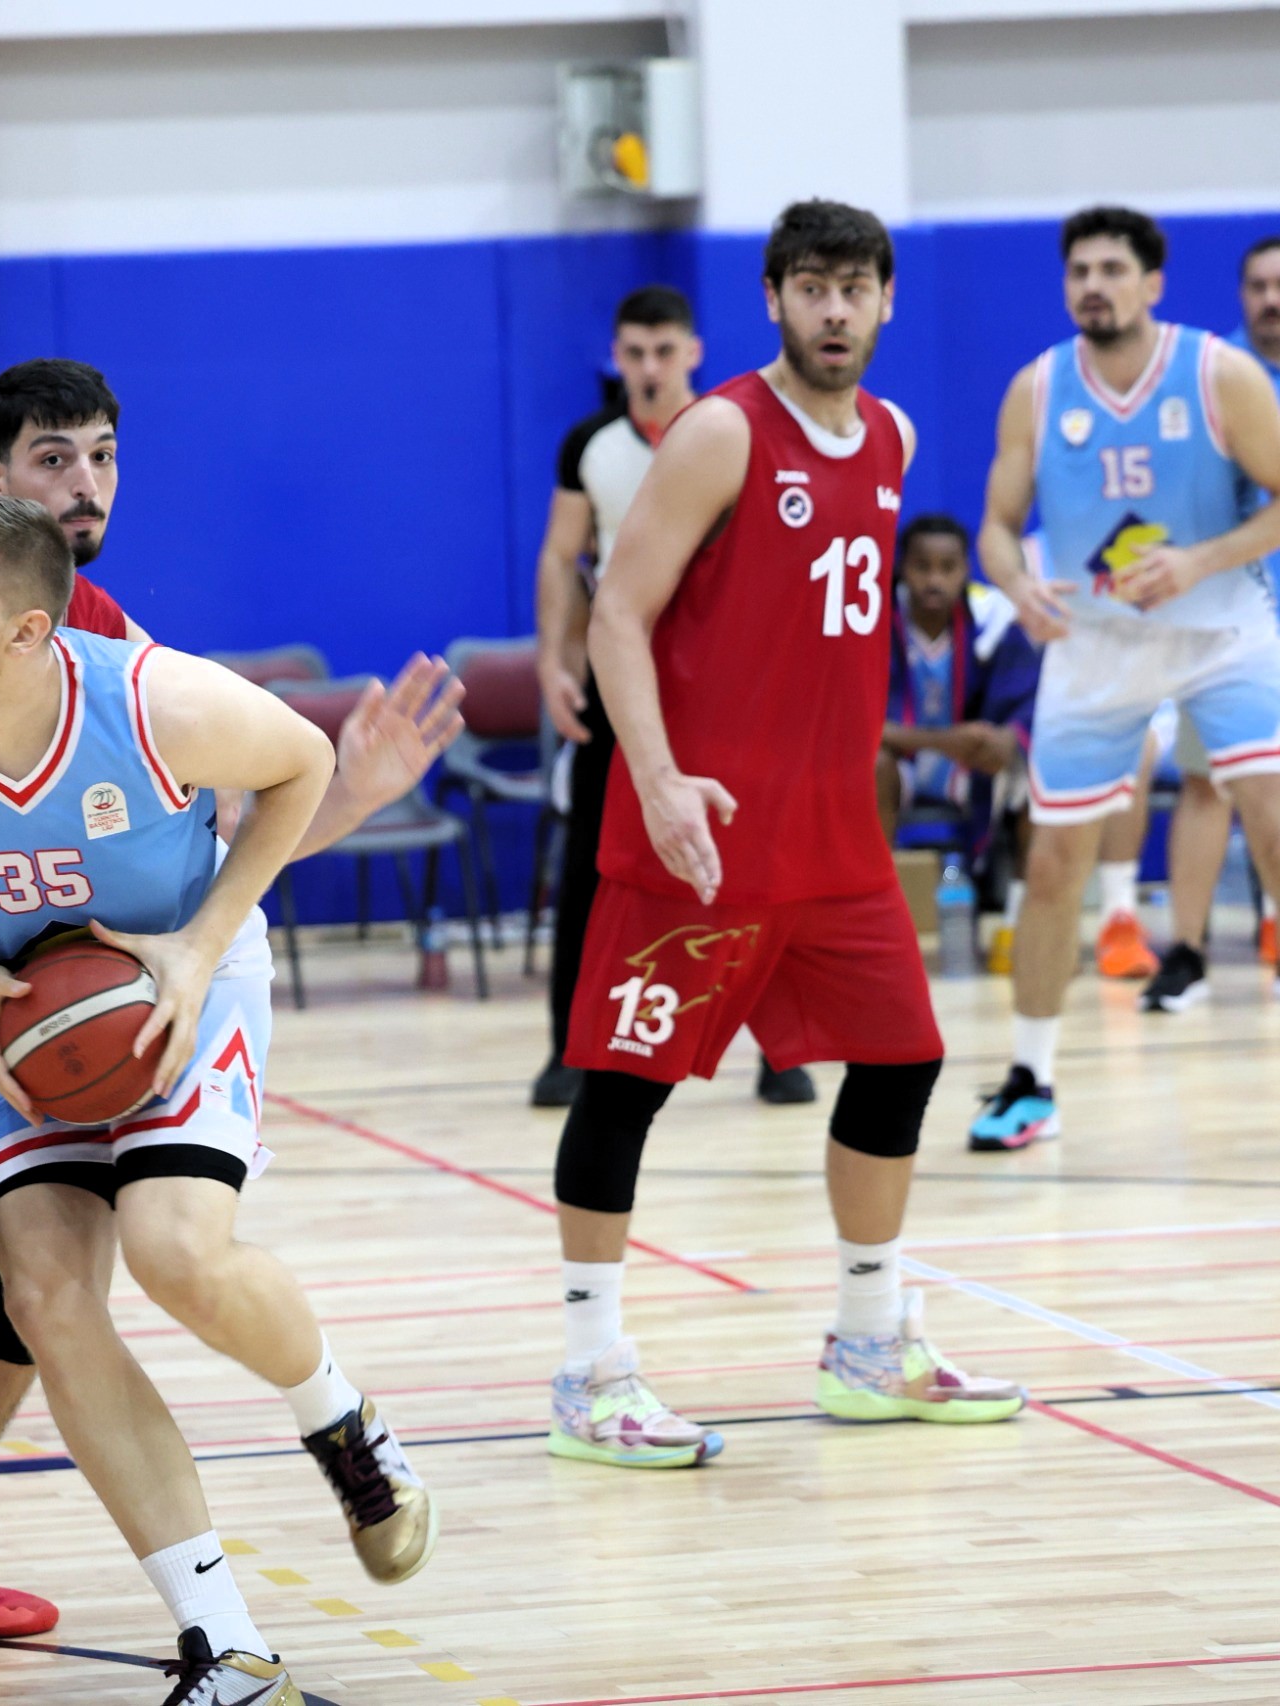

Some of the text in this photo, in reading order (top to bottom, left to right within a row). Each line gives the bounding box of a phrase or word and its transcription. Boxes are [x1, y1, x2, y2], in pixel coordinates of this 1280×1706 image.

[1100, 445, 1154, 499] 15
[809, 535, 882, 636] 13
[608, 976, 680, 1045] 13
